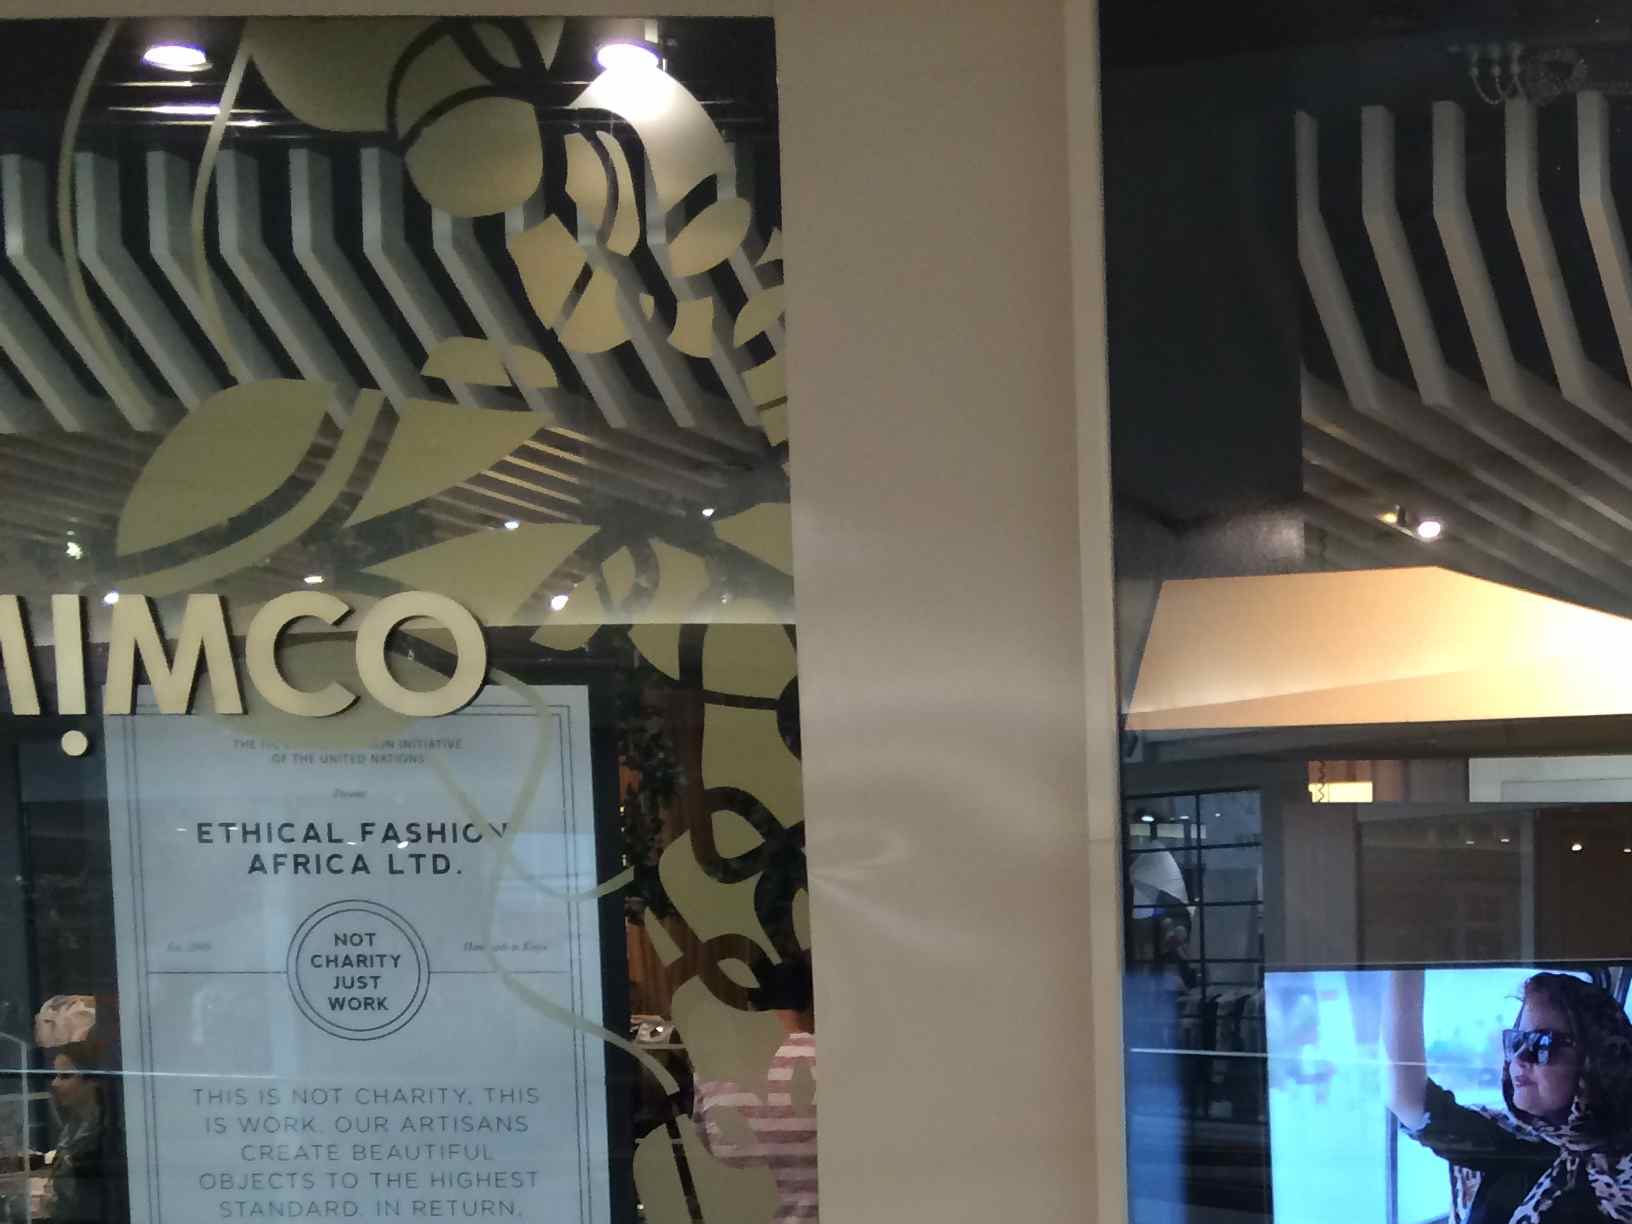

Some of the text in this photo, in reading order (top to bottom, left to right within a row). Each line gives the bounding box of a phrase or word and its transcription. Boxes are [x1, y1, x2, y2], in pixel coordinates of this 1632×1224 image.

[197, 822, 344, 843] ETHICAL
[248, 853, 462, 875] AFRICA LTD.
[334, 933, 377, 947] NOT
[311, 954, 401, 968] CHARITY
[332, 975, 382, 990] JUST
[328, 997, 388, 1010] WORK
[192, 1088, 248, 1105] THIS
[259, 1088, 280, 1105] IS
[292, 1088, 343, 1105] NOT
[486, 1087, 540, 1104] THIS
[205, 1117, 228, 1134] IS
[335, 1116, 388, 1133] OUR
[400, 1116, 529, 1133] ARTISANS
[241, 1144, 494, 1161] CREATE BEAUTIFUL
[199, 1172, 538, 1190] OBJECTS TO THE HIGHEST
[377, 1201, 400, 1216] IN
